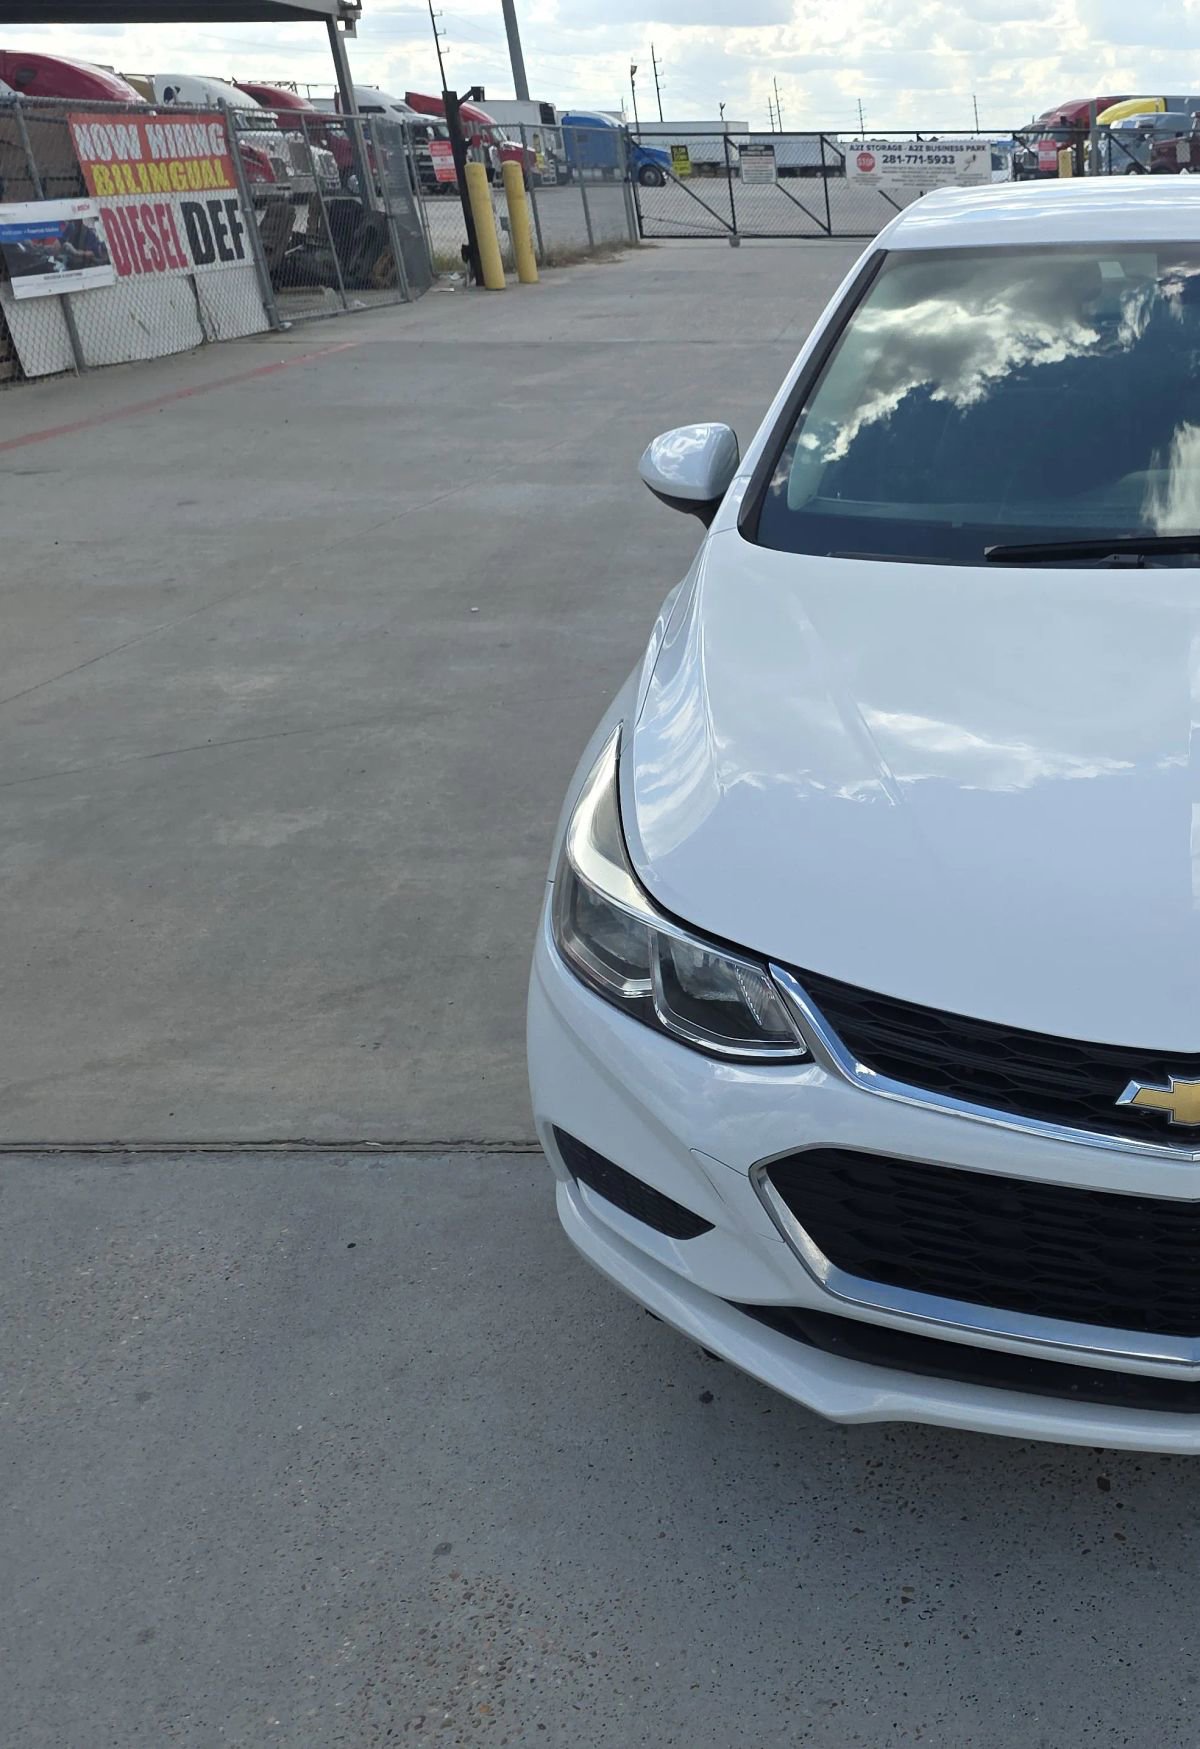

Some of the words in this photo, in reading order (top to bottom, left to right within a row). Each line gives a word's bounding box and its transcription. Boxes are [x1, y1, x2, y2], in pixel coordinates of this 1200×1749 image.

[72, 123, 143, 161] NOW
[144, 123, 227, 159] HIRING
[849, 144, 864, 152] A2Z
[866, 144, 903, 152] STORAGE
[908, 144, 924, 152] A2Z
[925, 144, 964, 152] BUSINESS
[966, 144, 987, 152] PARK
[882, 154, 955, 165] 281-771-5933
[90, 158, 230, 196] BILINGUAL
[100, 203, 189, 277] DIESEL
[179, 198, 246, 266] DEF
